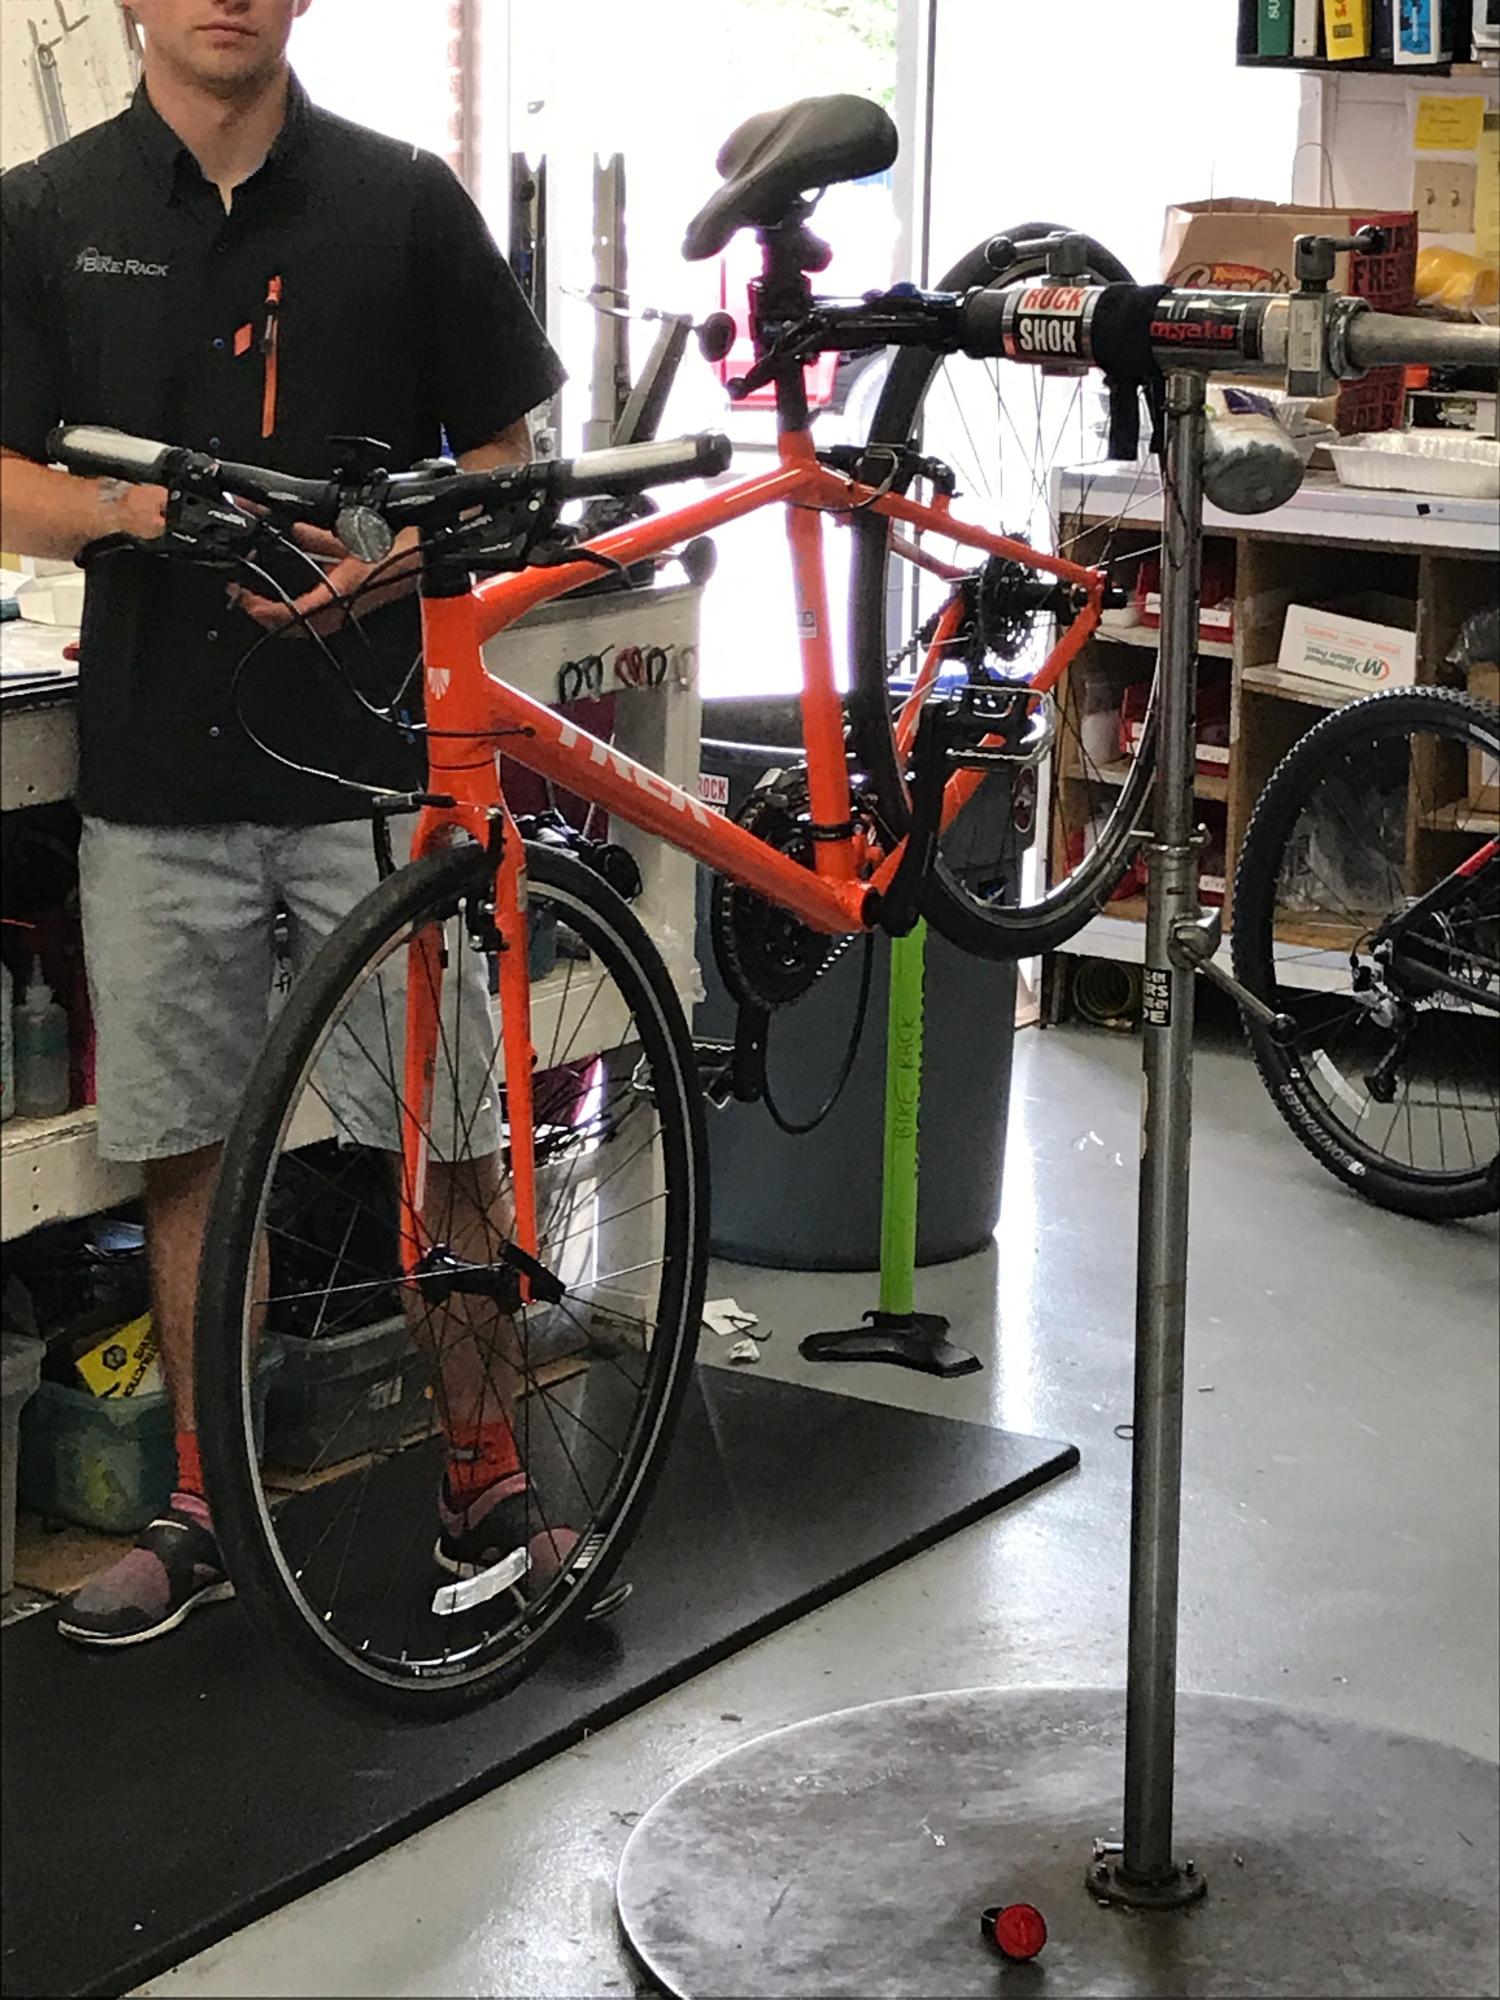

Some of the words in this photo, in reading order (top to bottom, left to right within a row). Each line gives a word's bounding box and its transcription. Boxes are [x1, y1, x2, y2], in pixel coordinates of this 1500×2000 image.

[124, 259, 169, 277] RACK
[1023, 287, 1087, 311] ROCK
[1019, 318, 1077, 353] SHOX
